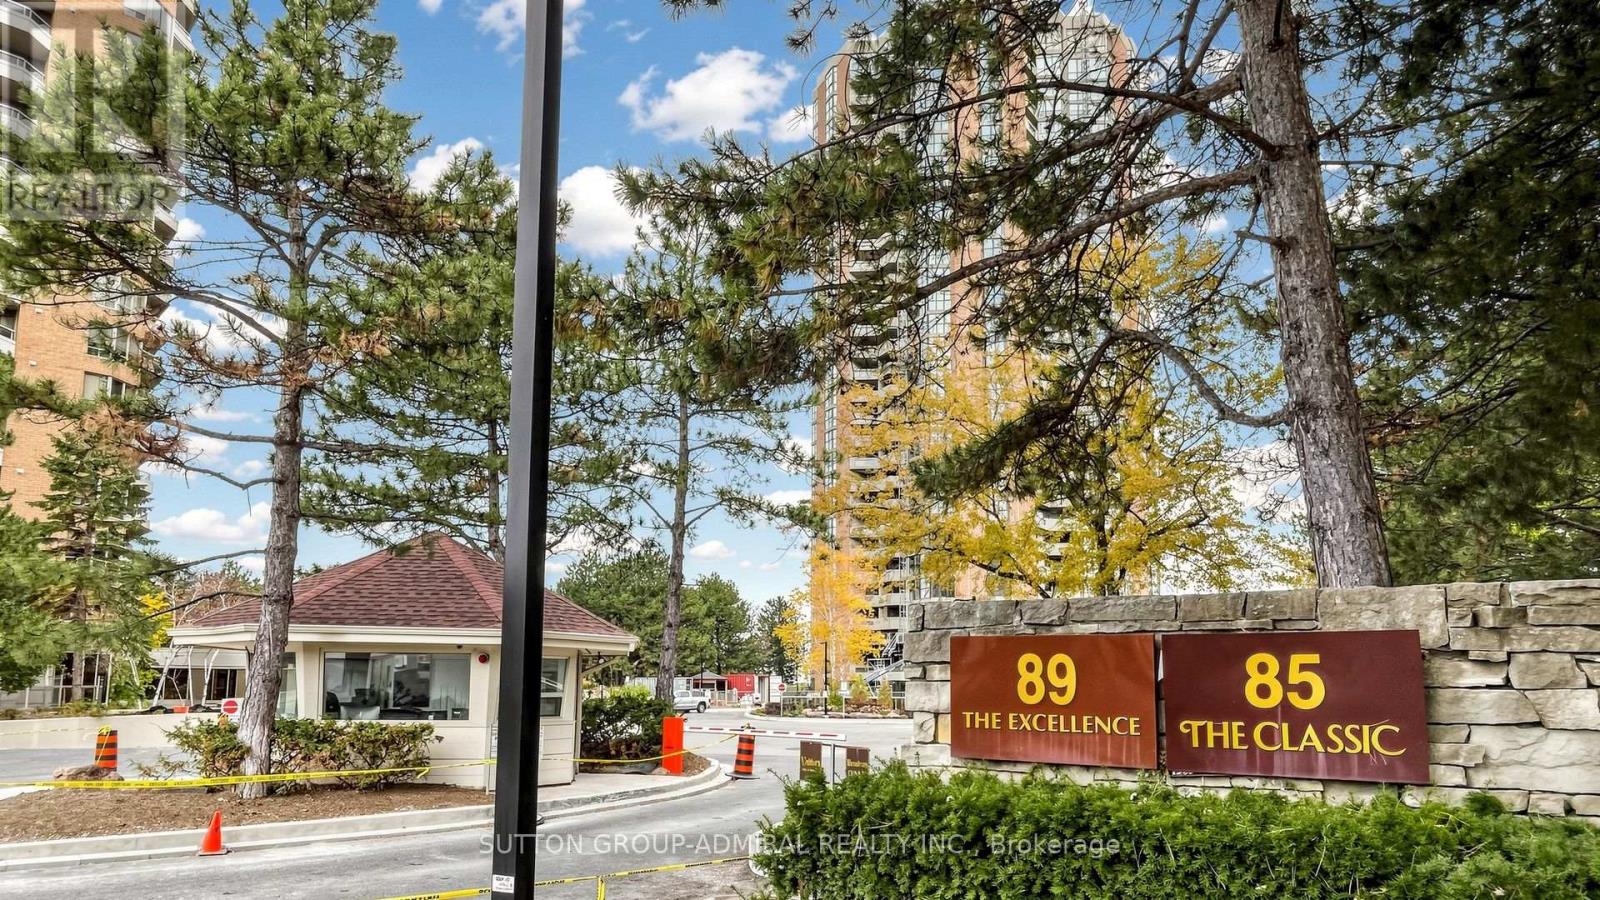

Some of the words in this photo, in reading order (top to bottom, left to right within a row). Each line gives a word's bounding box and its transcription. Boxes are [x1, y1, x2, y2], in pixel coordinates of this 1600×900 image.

[1017, 653, 1076, 705] 89
[1245, 653, 1325, 709] 85
[962, 712, 1001, 730] THE
[1009, 713, 1140, 737] EXCELLENCE
[1180, 720, 1248, 749] THE
[1253, 721, 1406, 757] CLASSIC
